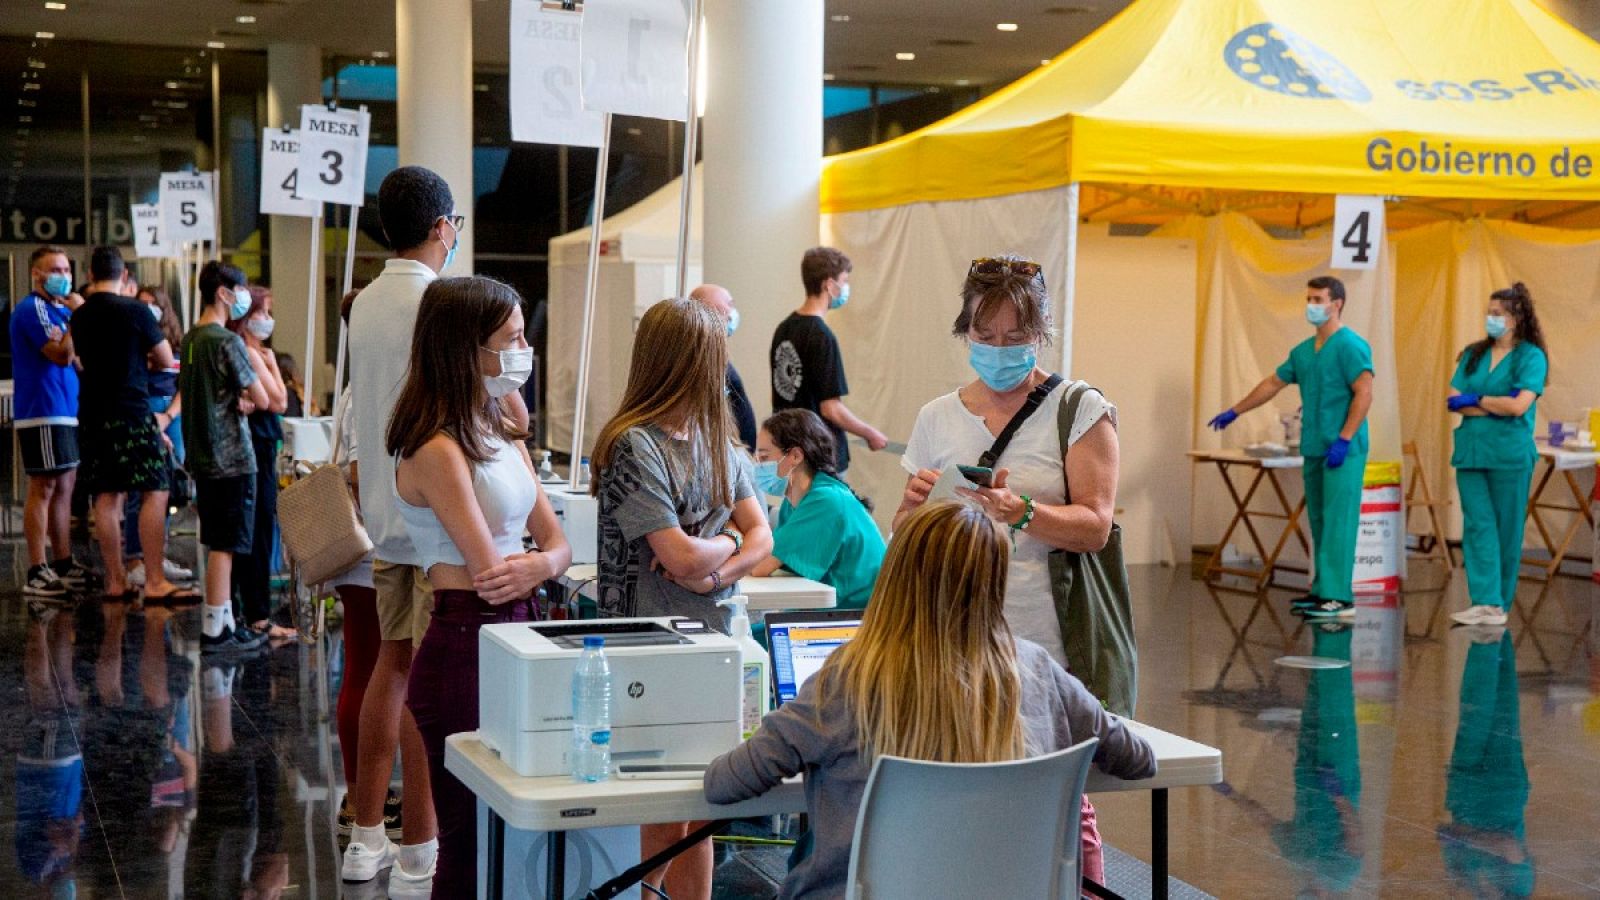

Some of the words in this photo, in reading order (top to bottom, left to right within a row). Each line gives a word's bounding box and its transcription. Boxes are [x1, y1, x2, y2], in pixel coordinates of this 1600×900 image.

[309, 119, 360, 137] MESA
[270, 139, 300, 153] ME
[1366, 138, 1536, 177] Gobierno
[1550, 147, 1593, 178] de
[319, 150, 344, 185] 3
[167, 180, 205, 191] MESA
[280, 167, 303, 200] 4
[180, 201, 199, 227] 5
[1340, 211, 1372, 263] 4
[628, 681, 644, 699] hp
